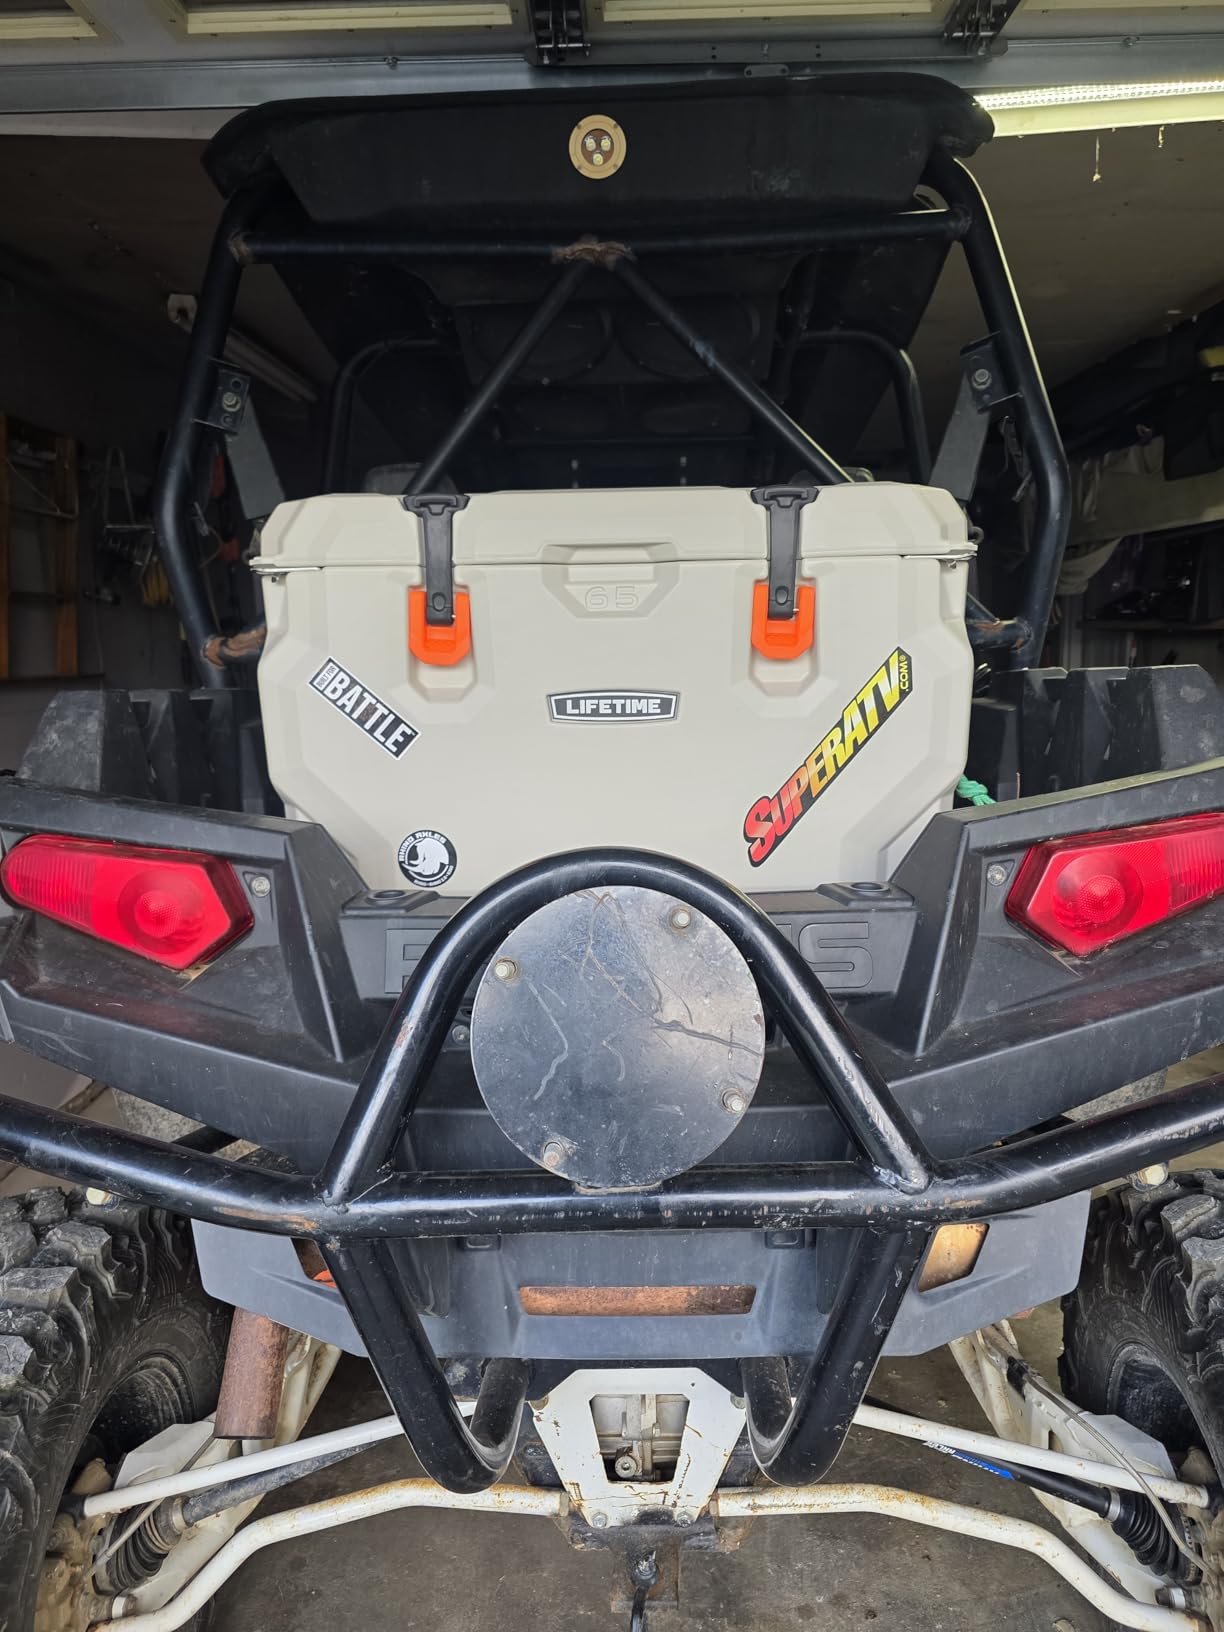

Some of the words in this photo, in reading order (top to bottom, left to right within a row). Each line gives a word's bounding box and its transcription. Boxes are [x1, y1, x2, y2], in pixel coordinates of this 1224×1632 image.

[585, 585, 640, 611] 65
[323, 670, 413, 753] BATTLE
[566, 698, 661, 714] LIFETIME
[745, 649, 900, 863] SUPERATV
[398, 835, 415, 862] RHINO
[414, 831, 447, 845] AXLES
